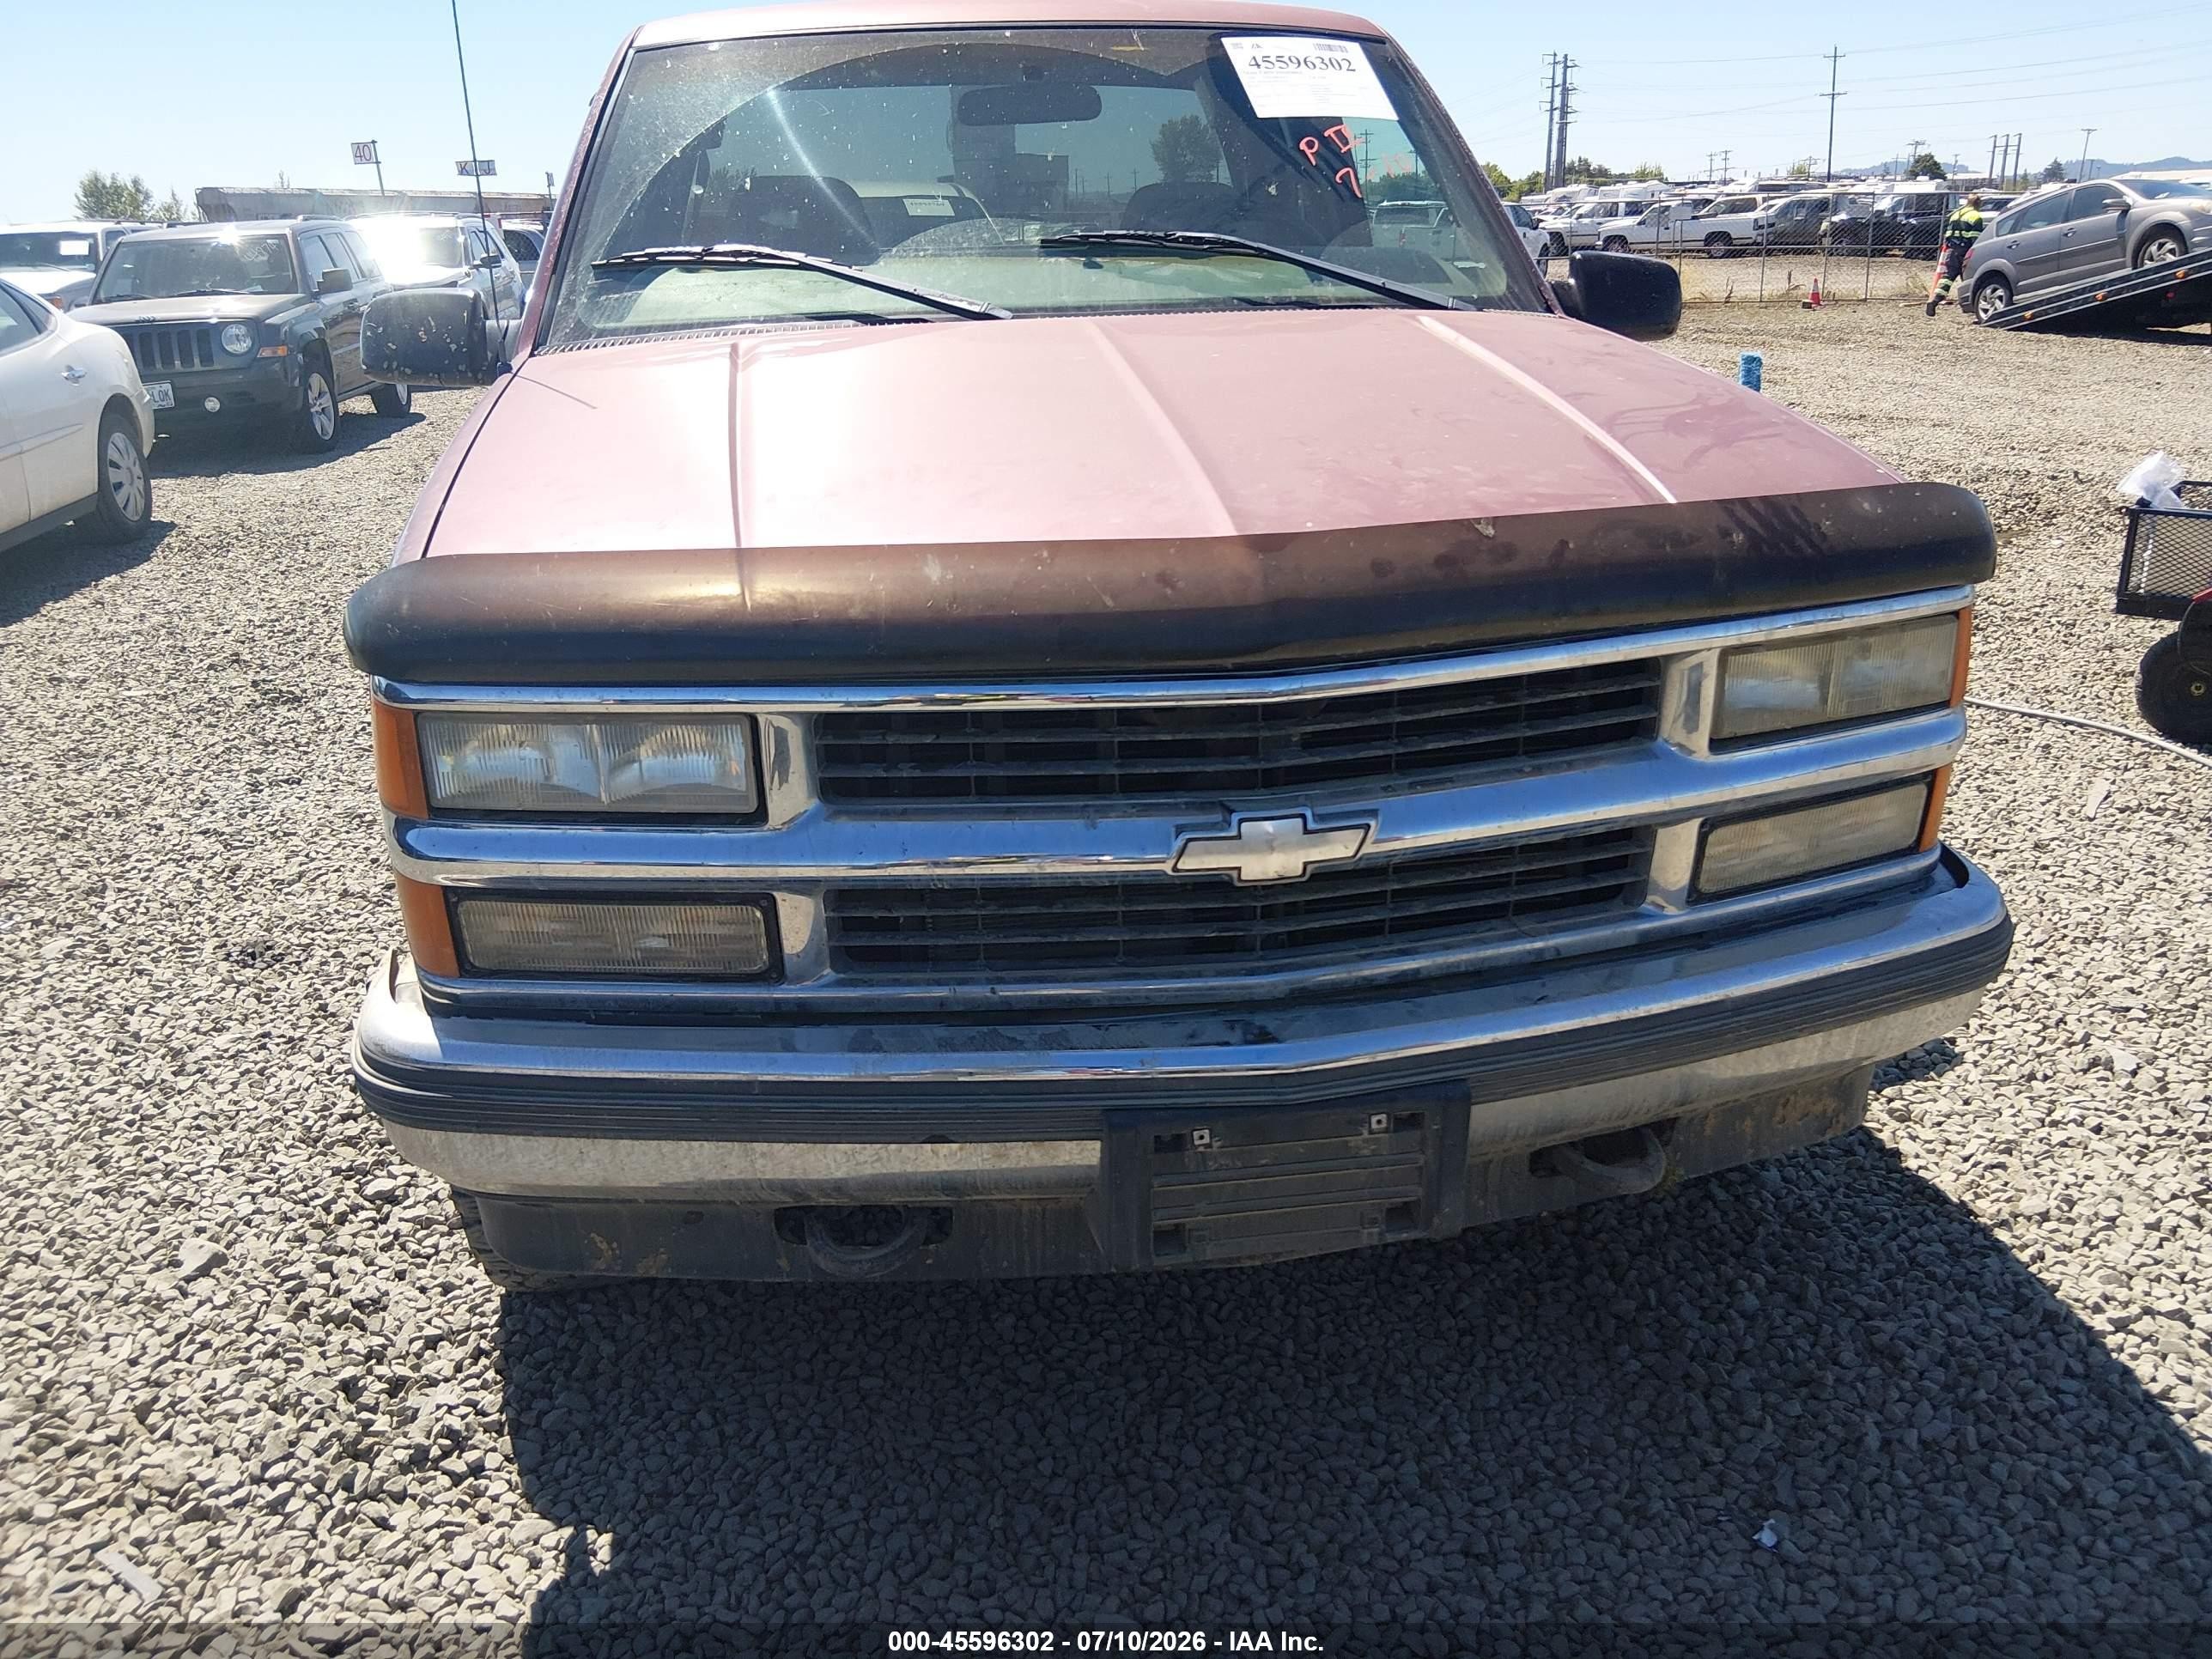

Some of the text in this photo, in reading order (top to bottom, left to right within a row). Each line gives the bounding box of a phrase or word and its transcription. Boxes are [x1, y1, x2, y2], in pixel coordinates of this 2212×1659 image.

[1249, 55, 1356, 72] 45596302
[355, 144, 372, 161] 40
[459, 162, 469, 174] K
